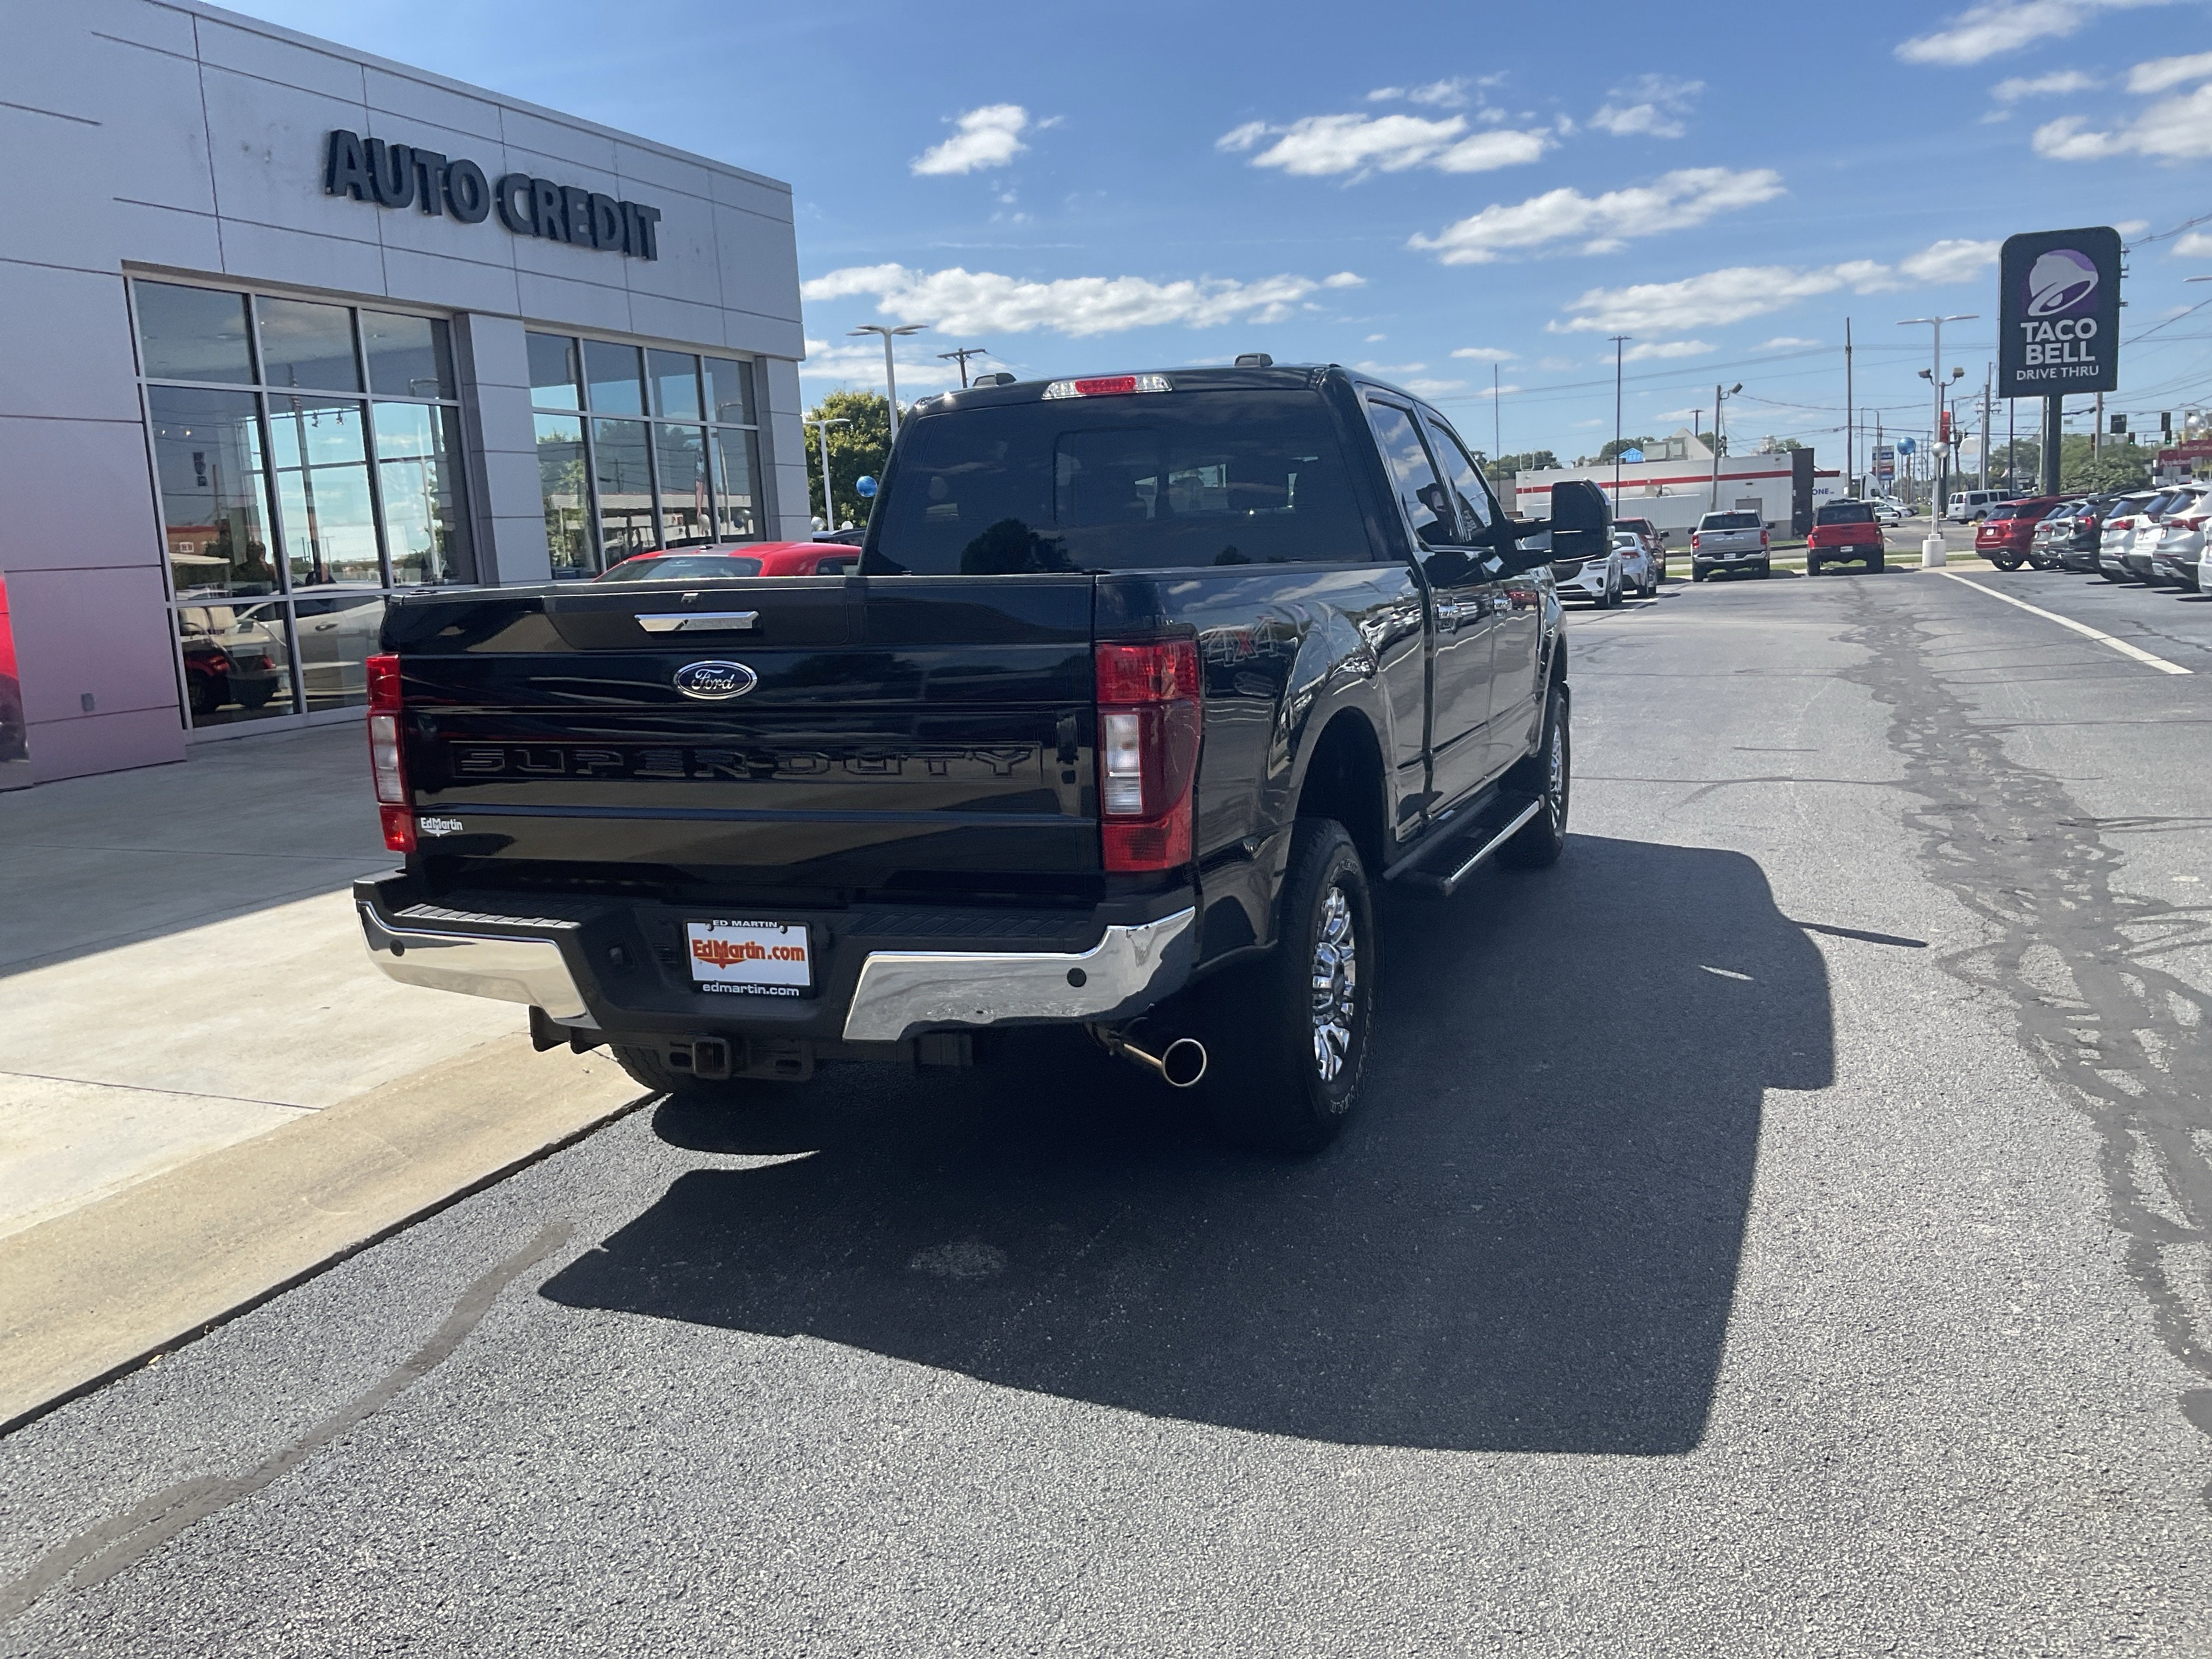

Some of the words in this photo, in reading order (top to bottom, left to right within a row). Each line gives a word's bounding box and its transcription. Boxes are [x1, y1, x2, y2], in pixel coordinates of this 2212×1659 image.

[326, 129, 490, 224] AUTO
[496, 172, 661, 261] CREDIT
[2020, 318, 2097, 342] TACO
[2026, 341, 2095, 365] BELL
[2017, 368, 2057, 380] DRIVE
[2060, 365, 2099, 377] THRU
[691, 669, 735, 690] Ford
[460, 748, 751, 778] SUPER
[772, 748, 1033, 778] DUTY
[692, 939, 806, 964] EdMartin.com
[703, 983, 799, 996] edmartin.com
